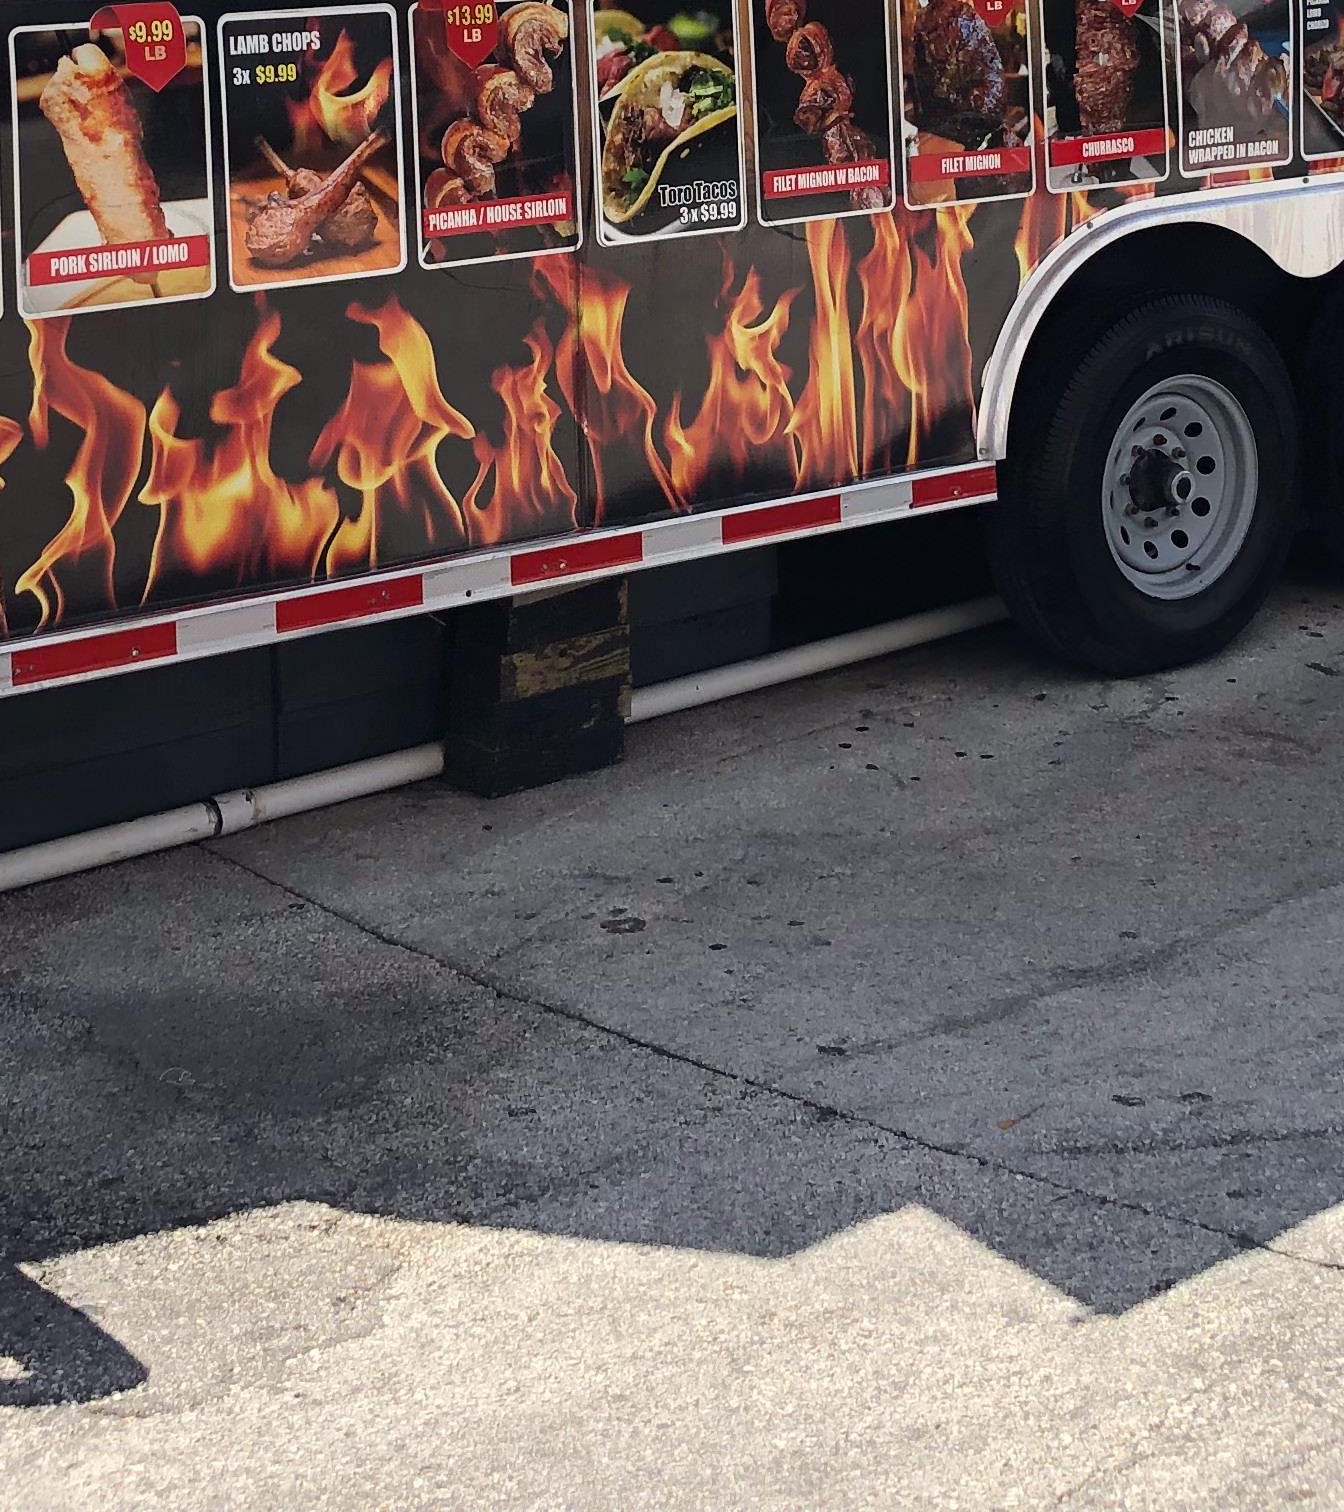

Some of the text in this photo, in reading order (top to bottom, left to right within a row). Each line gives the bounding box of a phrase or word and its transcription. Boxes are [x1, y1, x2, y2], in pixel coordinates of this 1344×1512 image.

[448, 4, 492, 25] $13.99
[986, 0, 1003, 10] LB
[128, 19, 174, 43] $9.99
[463, 29, 481, 42] LB
[145, 46, 166, 61] LB
[229, 30, 320, 56] LAMB CHOPS
[233, 63, 297, 85] 3x $9.99
[1189, 126, 1233, 147] CHICKEN
[1083, 138, 1134, 157] CHURRASCO
[1189, 140, 1279, 164] WRAPPED IN BACON
[942, 154, 1000, 174] FILET MIGNON
[773, 165, 879, 192] FILET MIGNON W BACON
[658, 180, 737, 207] Toro Tacos
[429, 209, 477, 230] PICANHA
[487, 204, 522, 223] HOUSE
[524, 199, 566, 220] SIRLOIN
[700, 202, 737, 221] $9.99
[51, 255, 86, 276] PORK
[89, 248, 140, 273] SIRLOIN
[153, 244, 188, 265] LOMO
